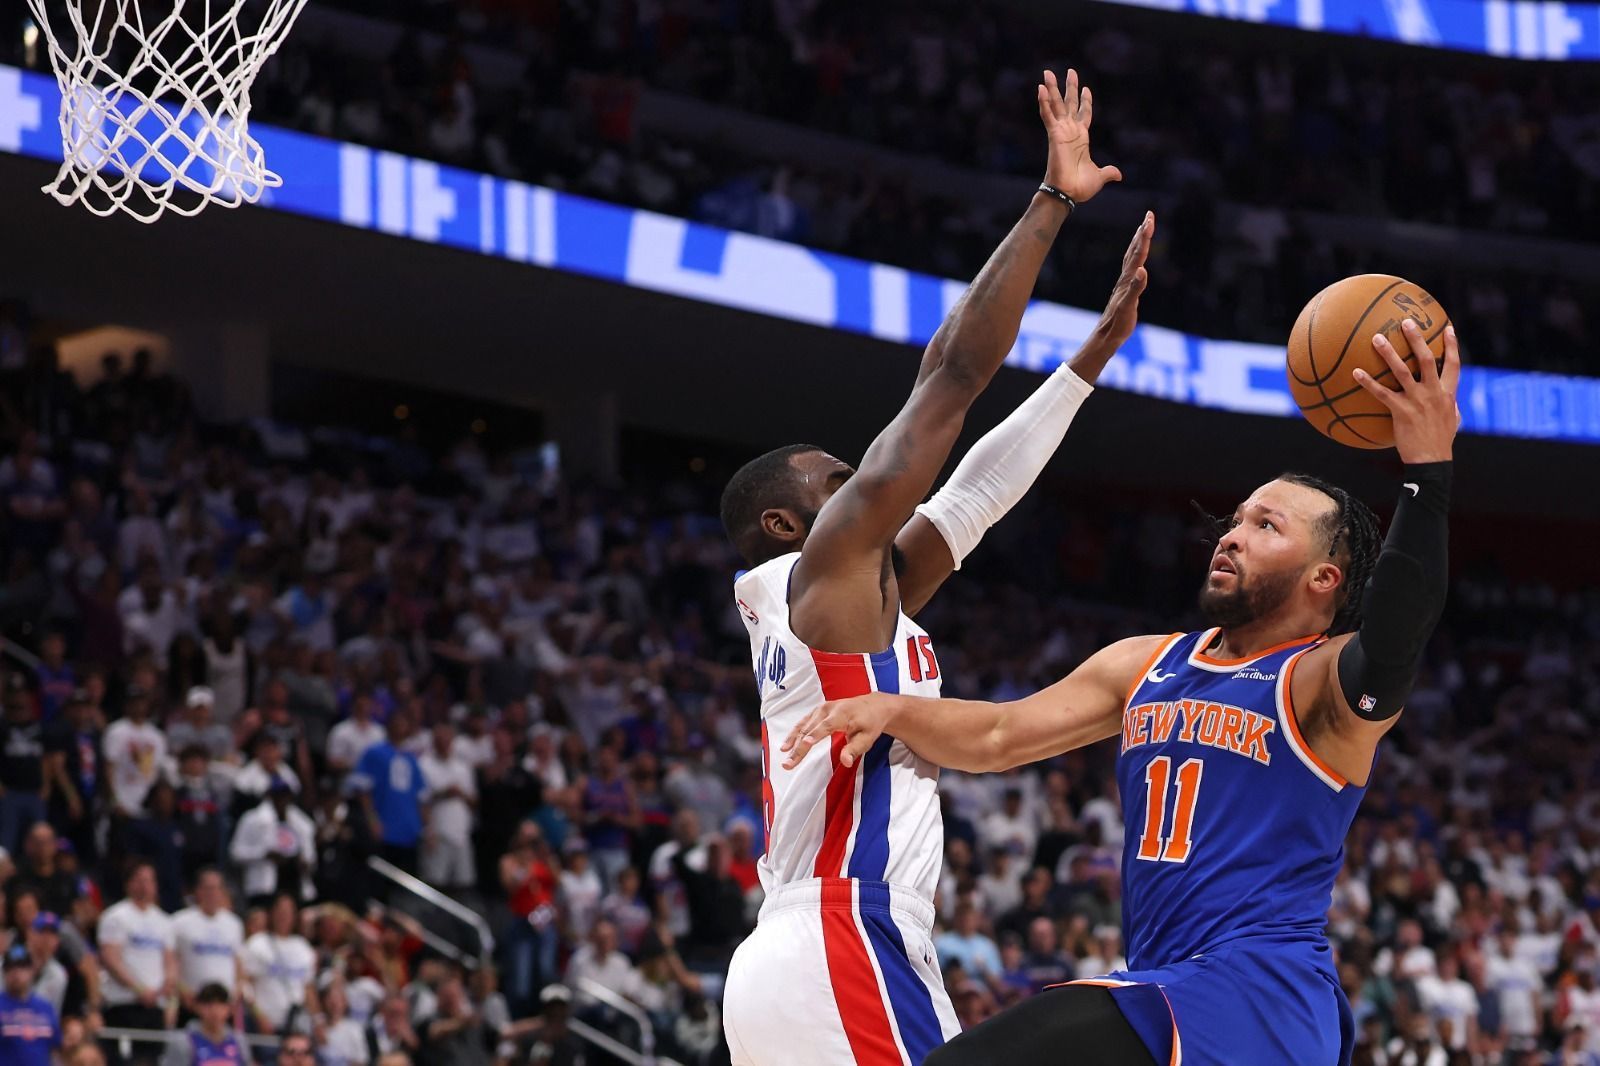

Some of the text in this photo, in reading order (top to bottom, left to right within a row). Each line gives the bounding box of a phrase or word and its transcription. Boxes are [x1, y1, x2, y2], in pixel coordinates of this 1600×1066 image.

[1121, 697, 1276, 767] NEW YORK
[1136, 756, 1203, 863] 11
